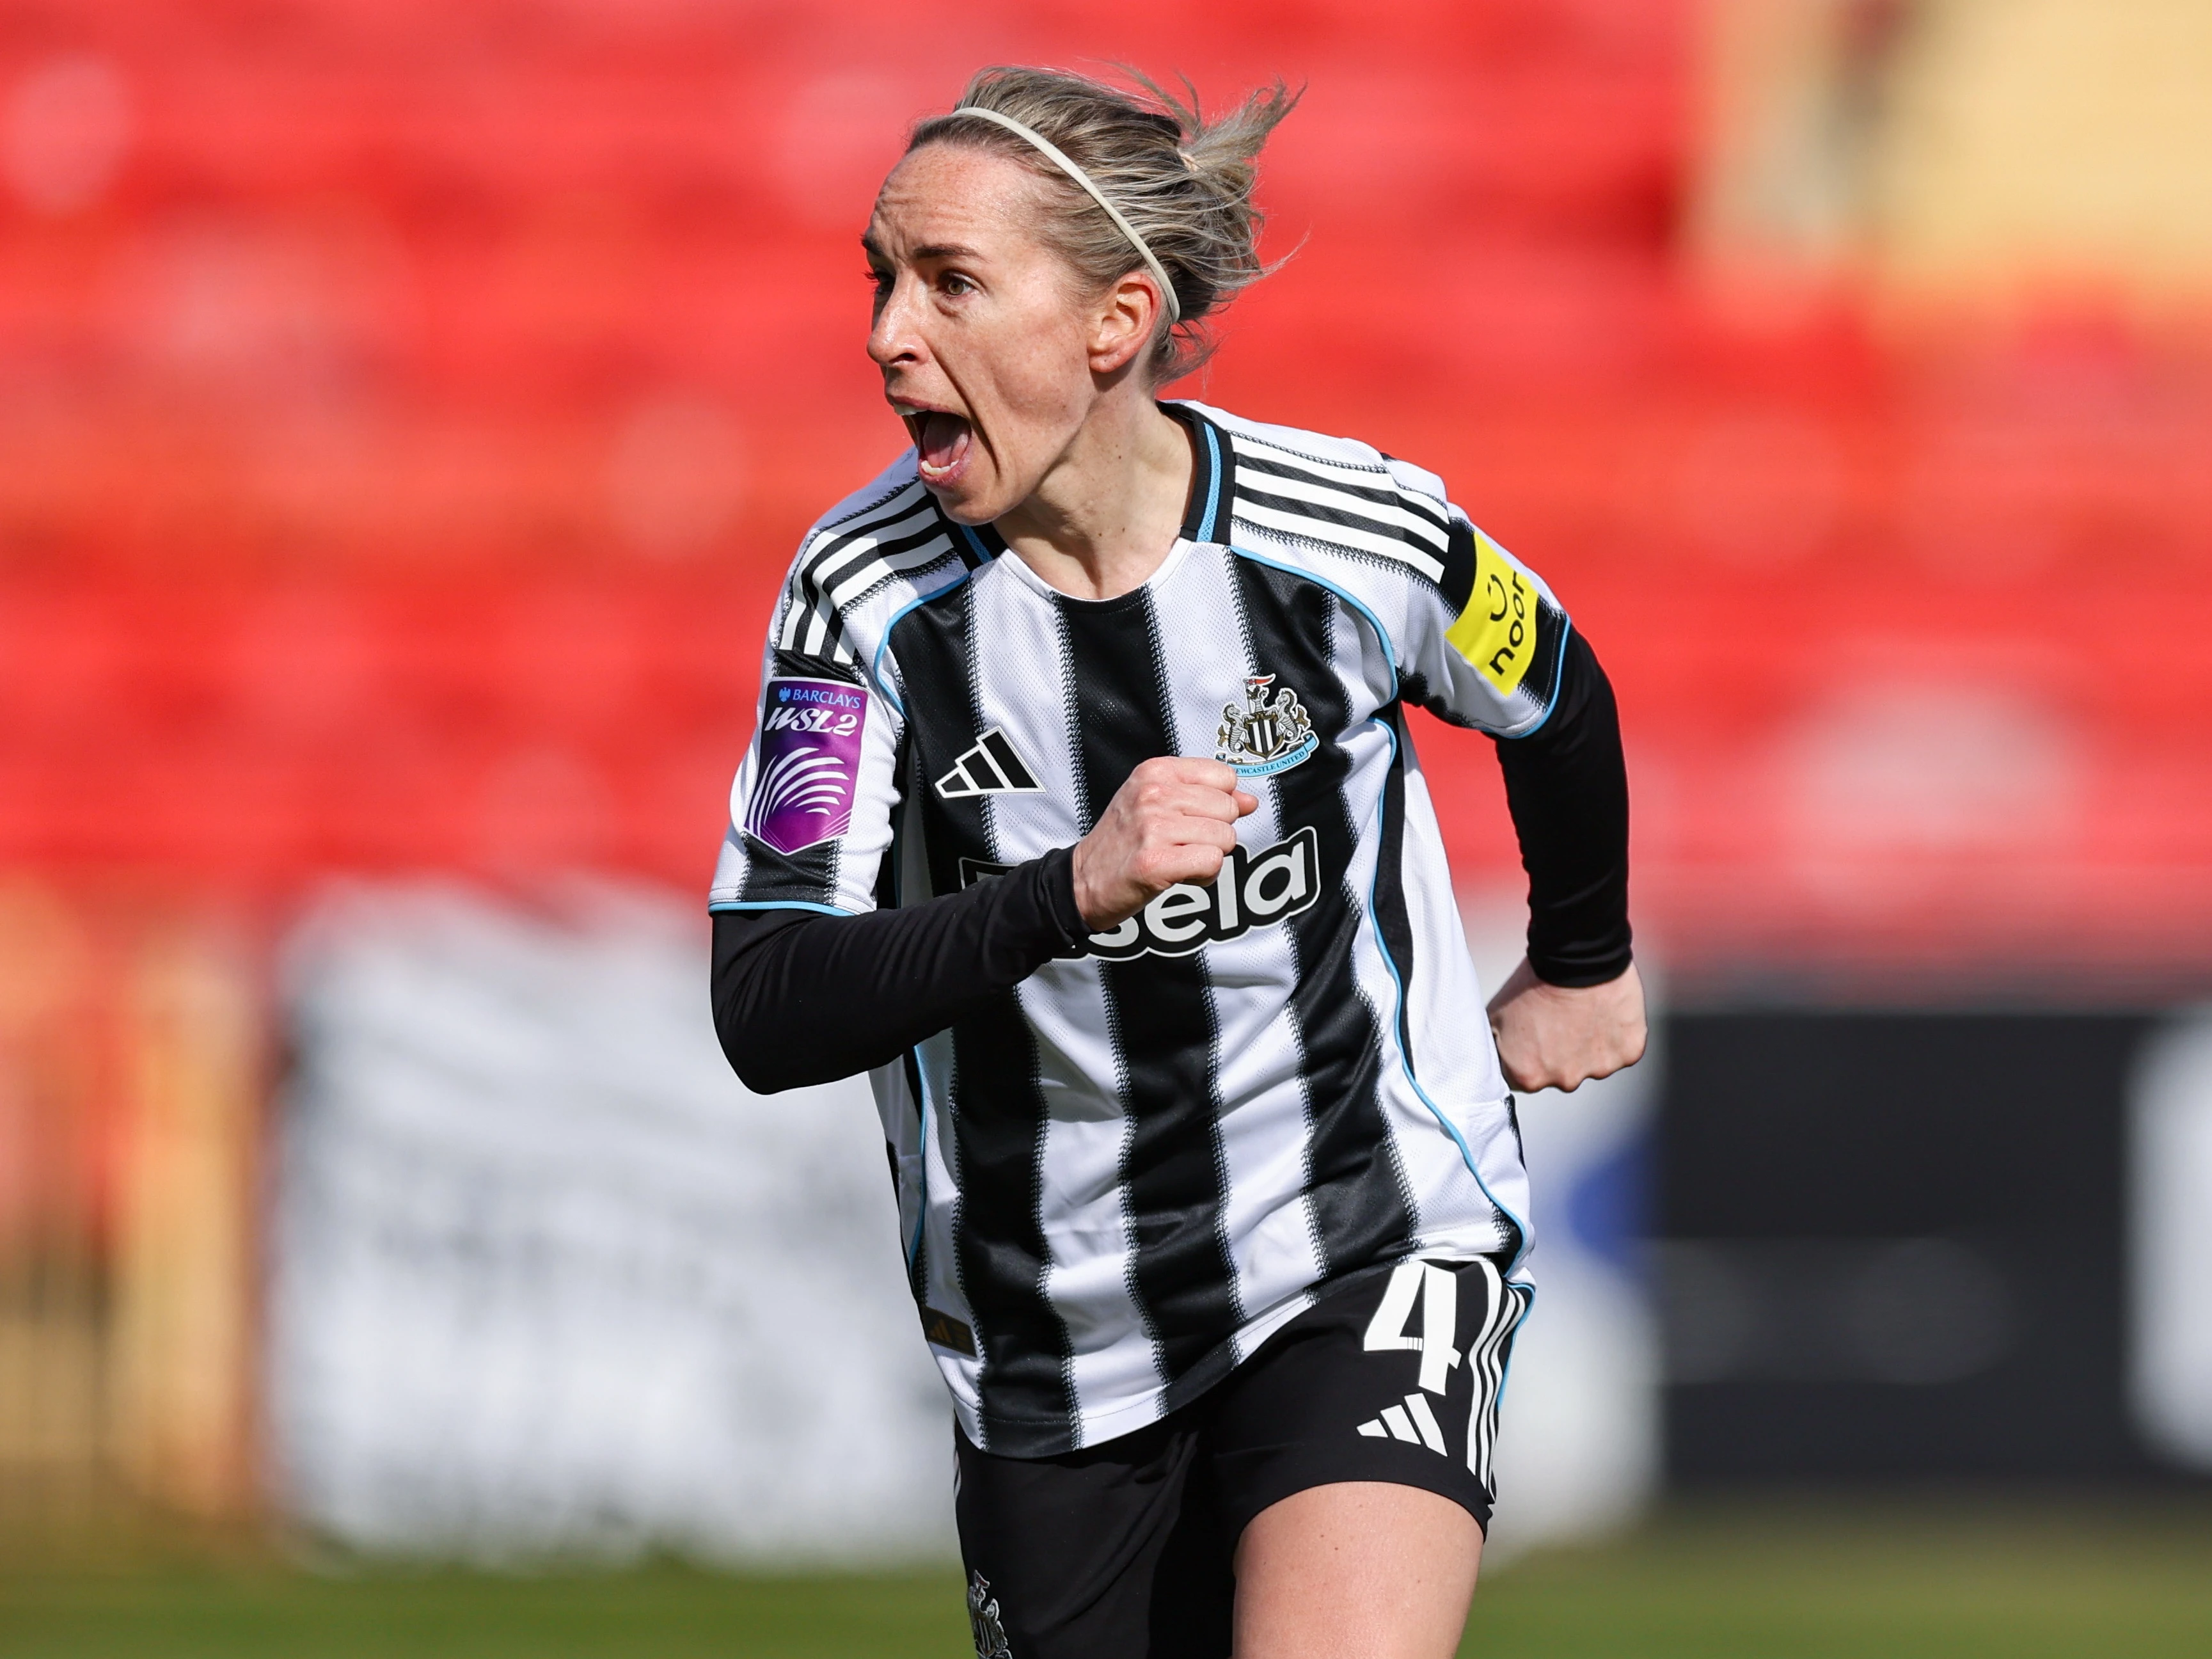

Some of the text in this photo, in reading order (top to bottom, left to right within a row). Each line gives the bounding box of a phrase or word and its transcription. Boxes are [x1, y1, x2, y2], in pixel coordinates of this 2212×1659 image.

[793, 689, 860, 709] BARCLAYS
[764, 708, 857, 736] WSL2
[1235, 751, 1304, 774] EWCASTLE UNITED
[1364, 1260, 1462, 1396] 4
